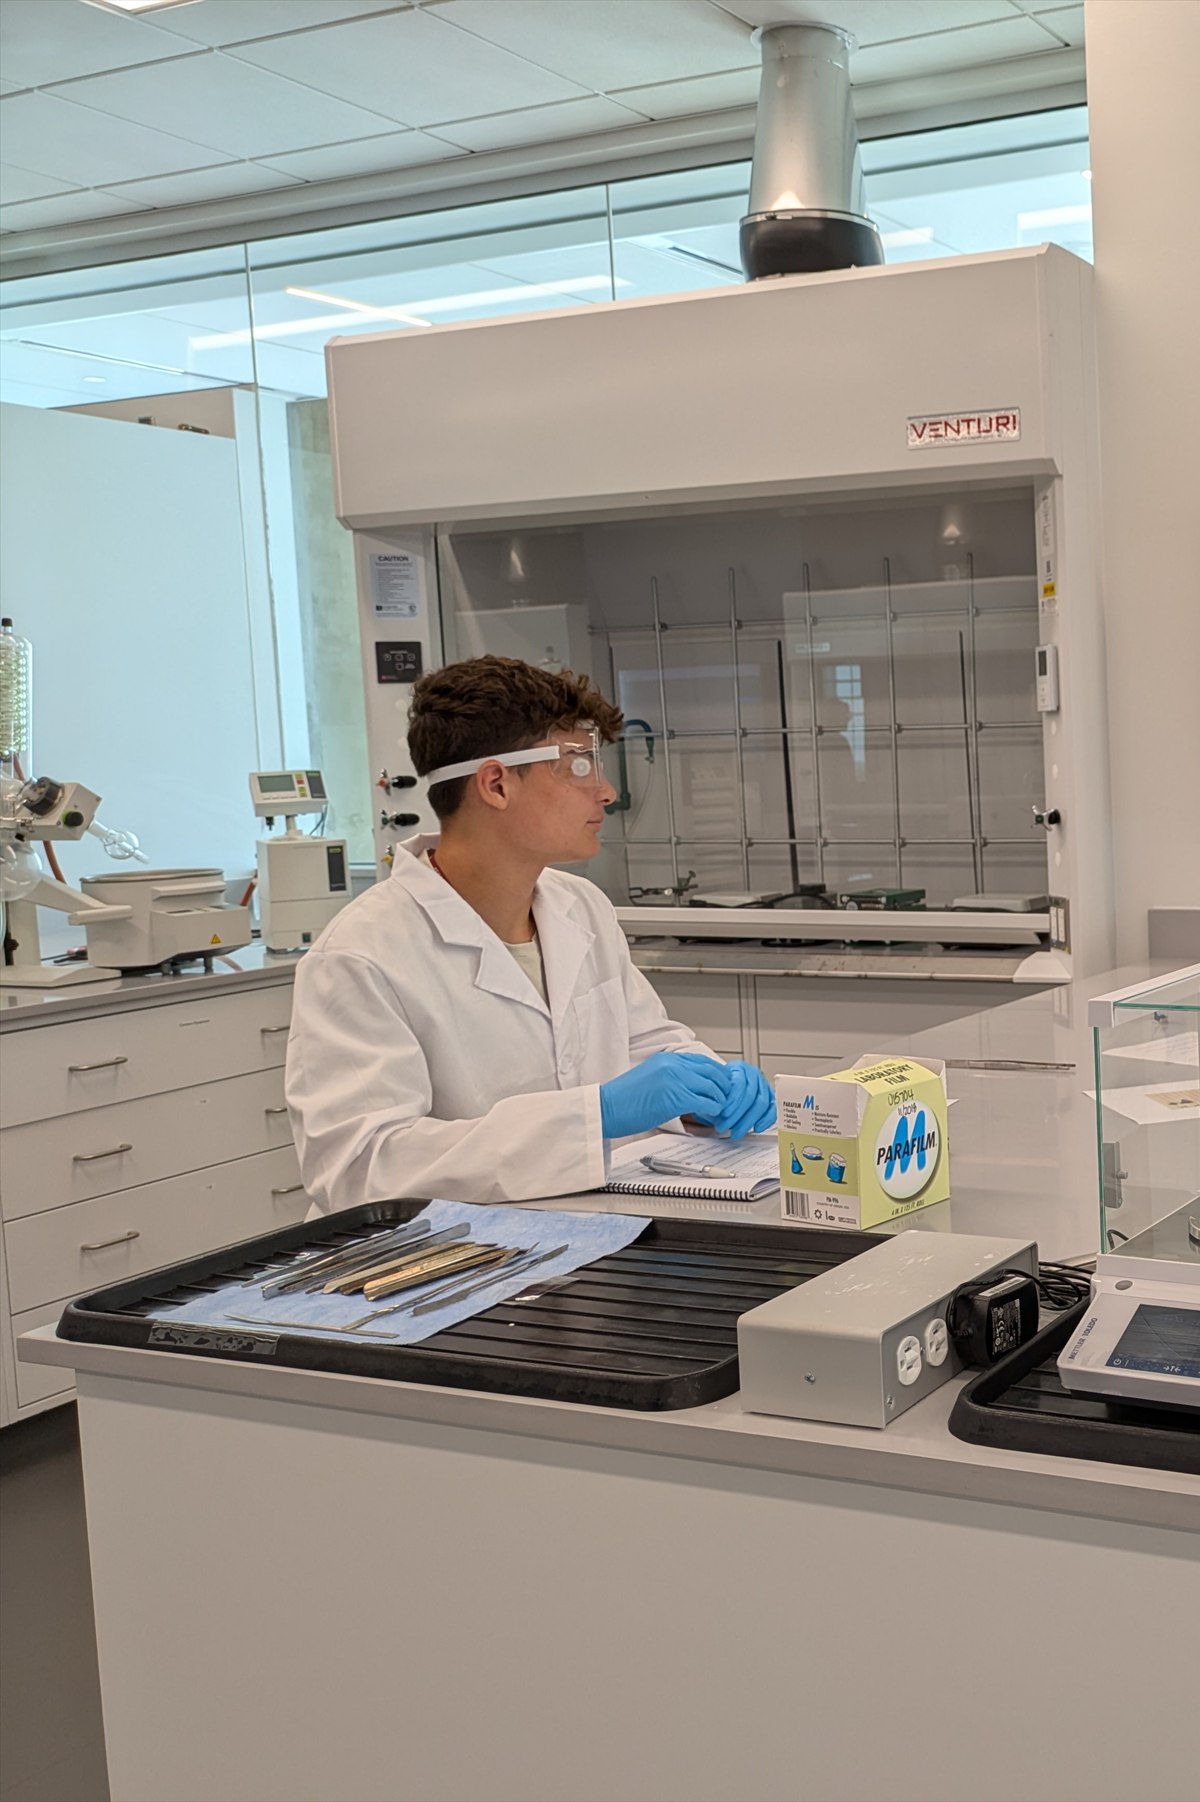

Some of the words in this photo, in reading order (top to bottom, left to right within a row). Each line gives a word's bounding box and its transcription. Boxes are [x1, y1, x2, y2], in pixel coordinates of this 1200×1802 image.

[911, 414, 1017, 439] VENTURI
[854, 1064, 914, 1083] LABORATORY
[884, 1074, 910, 1085] FILM
[803, 1095, 815, 1110] M
[876, 1131, 936, 1166] PARAFILM
[1068, 1337, 1086, 1360] METTLER
[1082, 1317, 1098, 1337] TOLEDO
